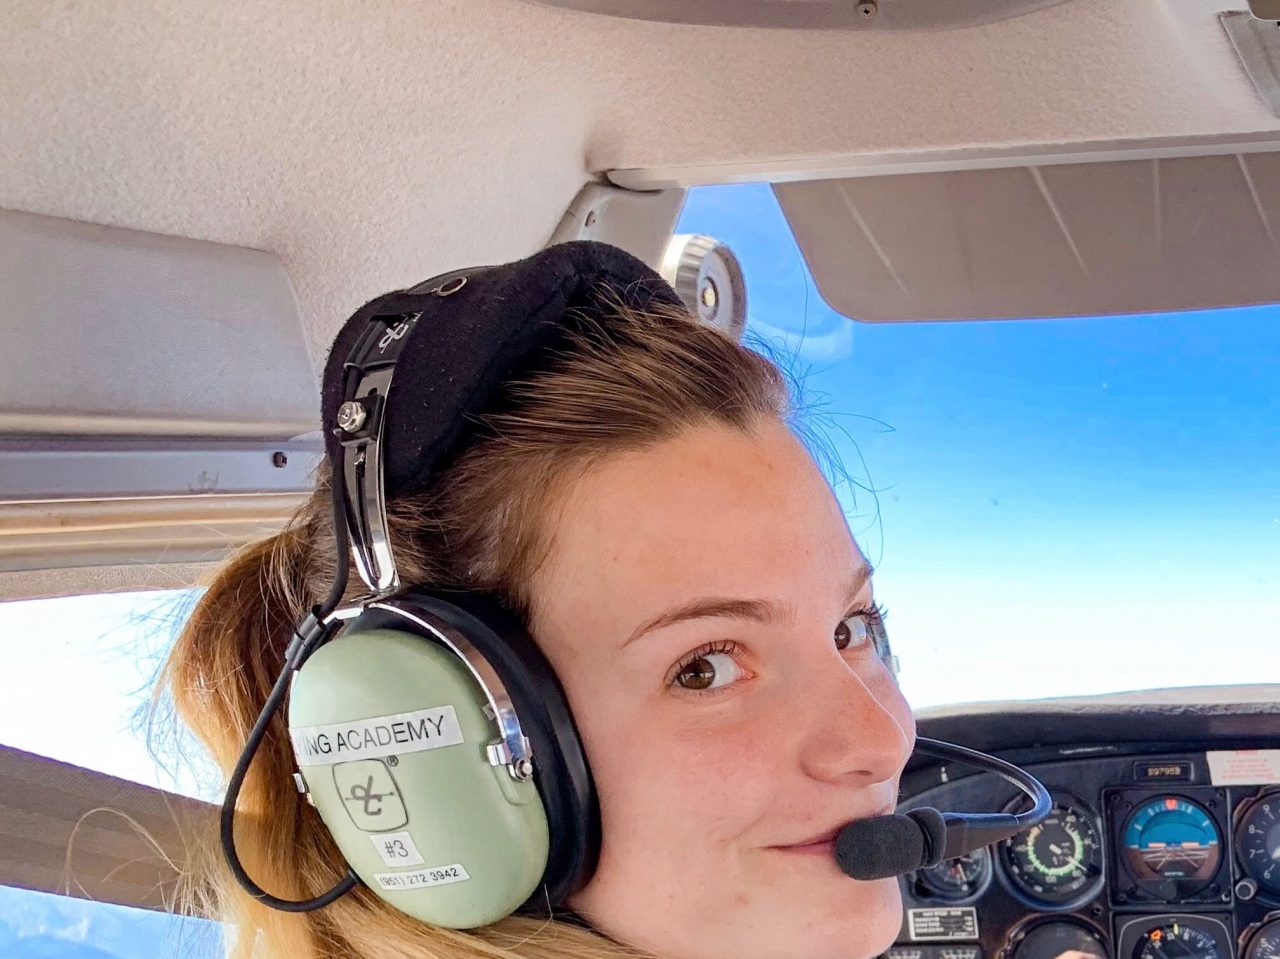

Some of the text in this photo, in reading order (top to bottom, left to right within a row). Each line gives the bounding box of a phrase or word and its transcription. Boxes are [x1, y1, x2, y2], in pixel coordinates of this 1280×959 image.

[337, 715, 444, 752] ACADEMY
[1263, 804, 1270, 814] 9
[1248, 824, 1255, 834] 8
[385, 839, 409, 858] #3
[1249, 849, 1256, 859] 7
[406, 873, 427, 885] 272
[430, 867, 460, 881] 3942
[1263, 869, 1271, 879] 6
[1260, 938, 1268, 947] 5
